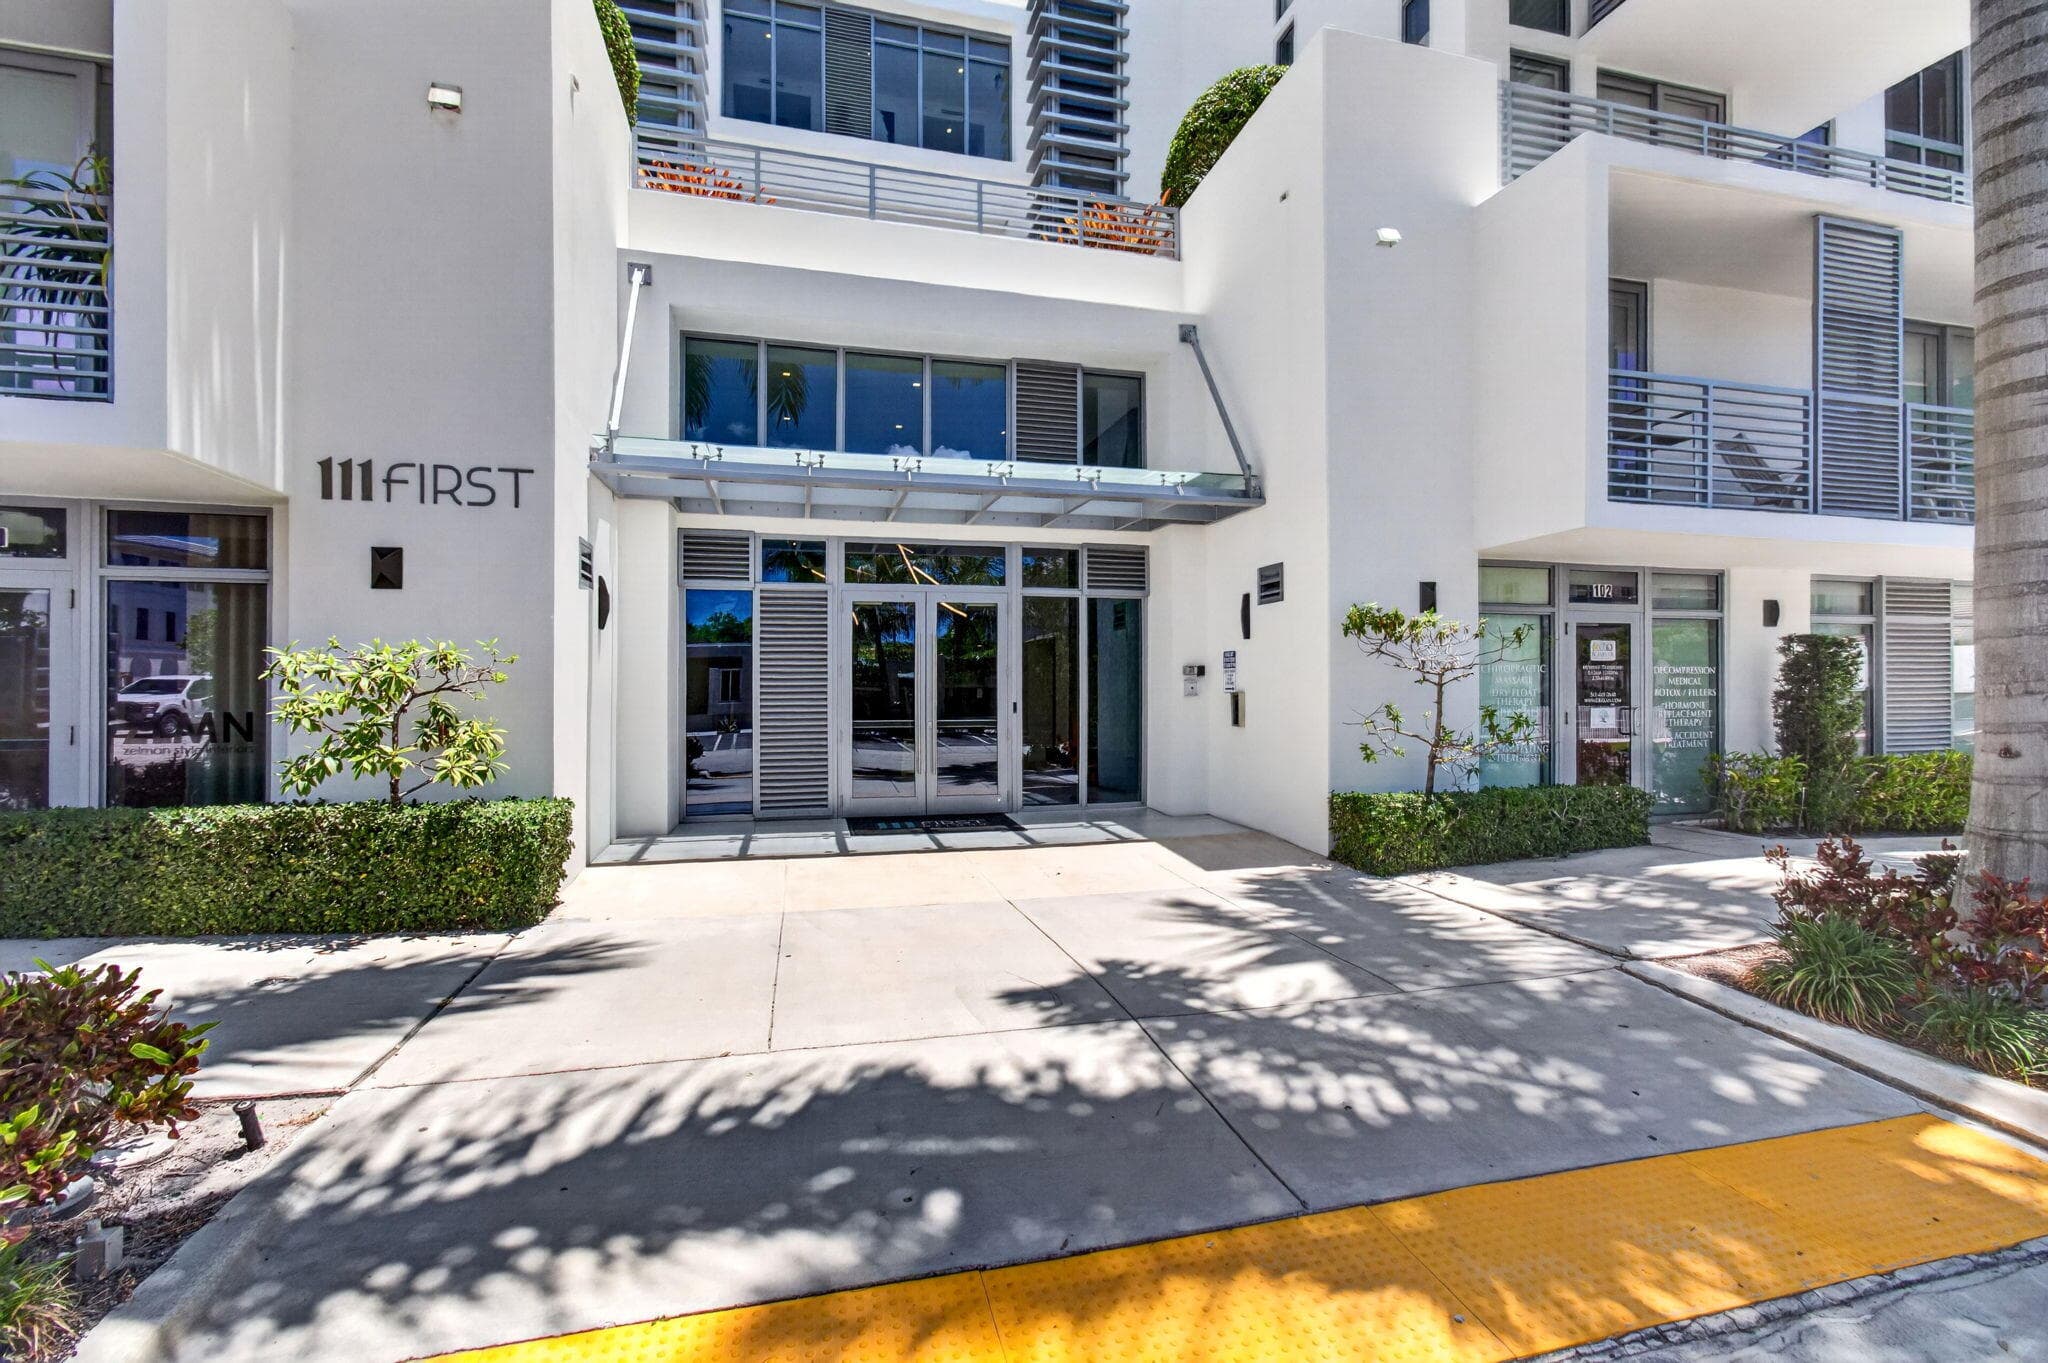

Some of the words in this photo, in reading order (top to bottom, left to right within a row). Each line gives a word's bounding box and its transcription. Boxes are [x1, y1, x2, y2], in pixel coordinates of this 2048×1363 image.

[316, 456, 373, 501] 111
[382, 462, 535, 508] FIRST
[1593, 584, 1612, 598] 102
[1653, 666, 1716, 674] DECOMPRESSION
[1668, 677, 1702, 685] MEDICAL
[1654, 688, 1681, 697] BOTOX
[1688, 688, 1717, 697] FILLERS
[1664, 701, 1706, 710] HORMONE
[1658, 709, 1713, 718] REPLACEMENT
[1669, 718, 1703, 727] THERAPY
[1674, 731, 1713, 739] ACCIDENT
